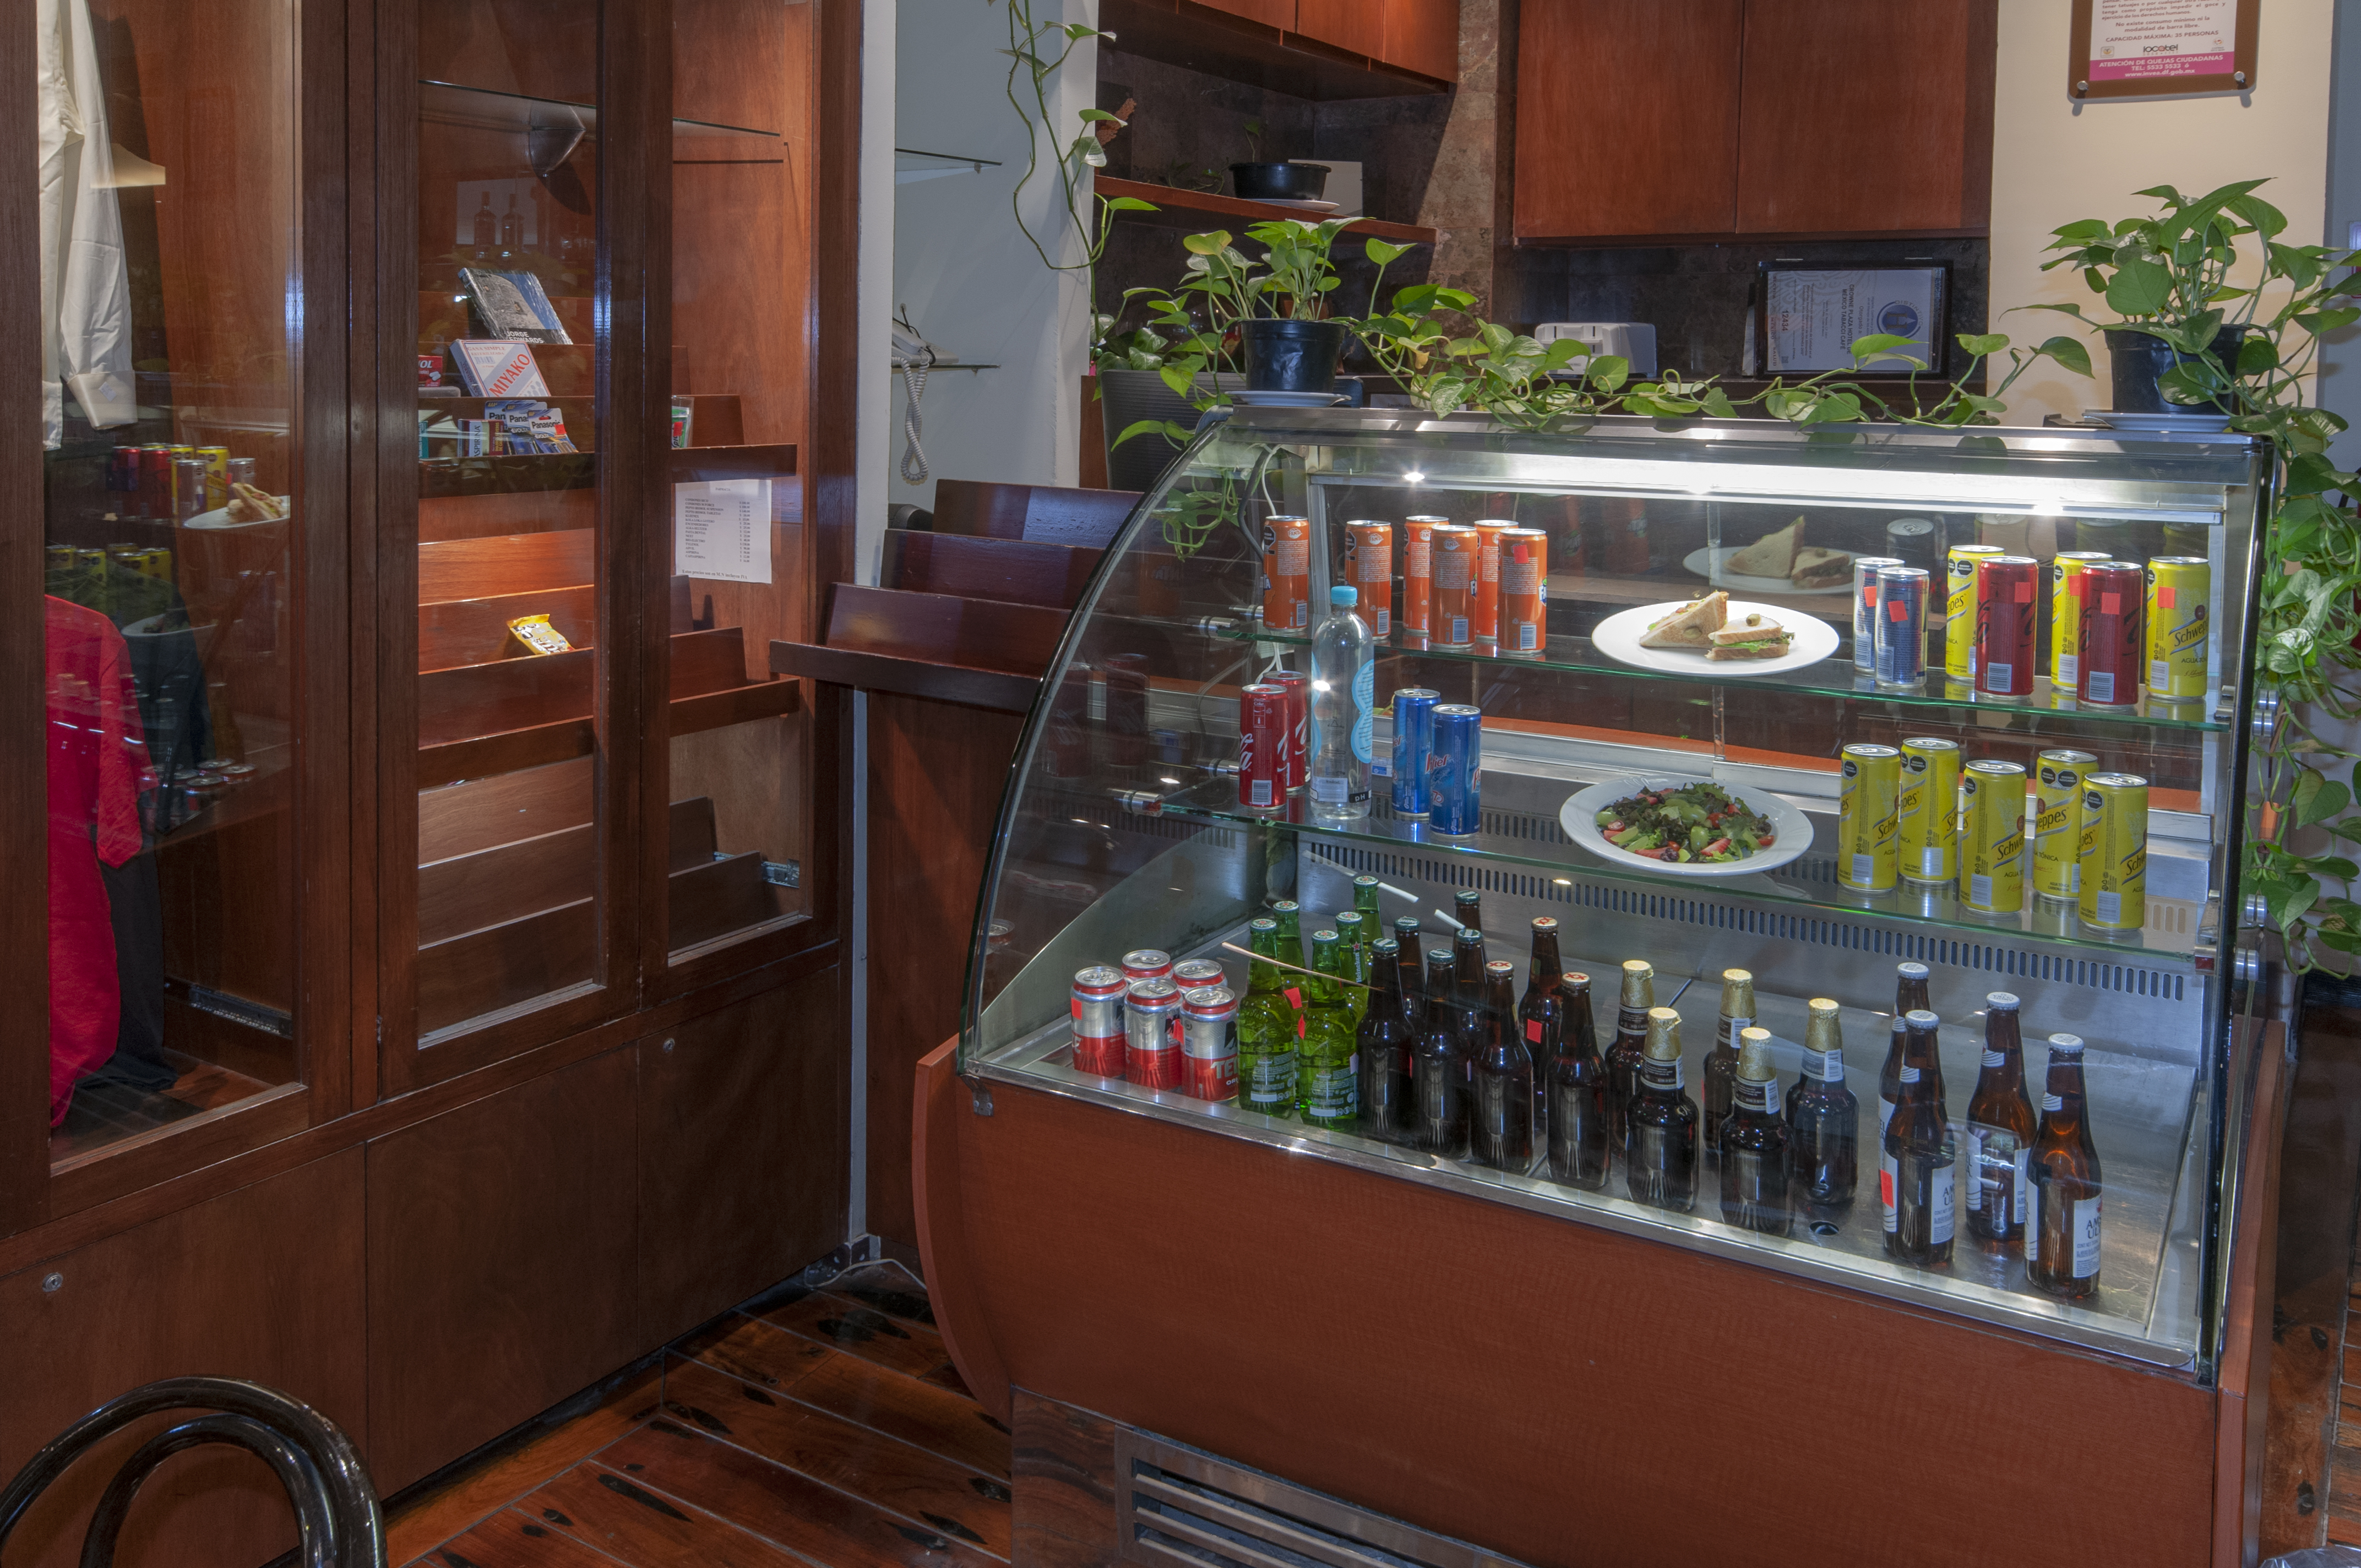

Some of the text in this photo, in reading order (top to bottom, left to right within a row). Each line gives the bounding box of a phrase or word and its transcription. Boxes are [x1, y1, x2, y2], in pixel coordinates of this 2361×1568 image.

[2143, 44, 2178, 53] locatel
[2099, 59, 2134, 67] ATENCIÓN
[2125, 68, 2195, 77] www.invea.df.gob.mx
[1895, 300, 1923, 326] DISTINTIVO
[1886, 312, 1907, 330] H
[488, 353, 530, 397] MIYAKO
[1354, 794, 1366, 802] pH
[2039, 851, 2059, 862] TÓNICA
